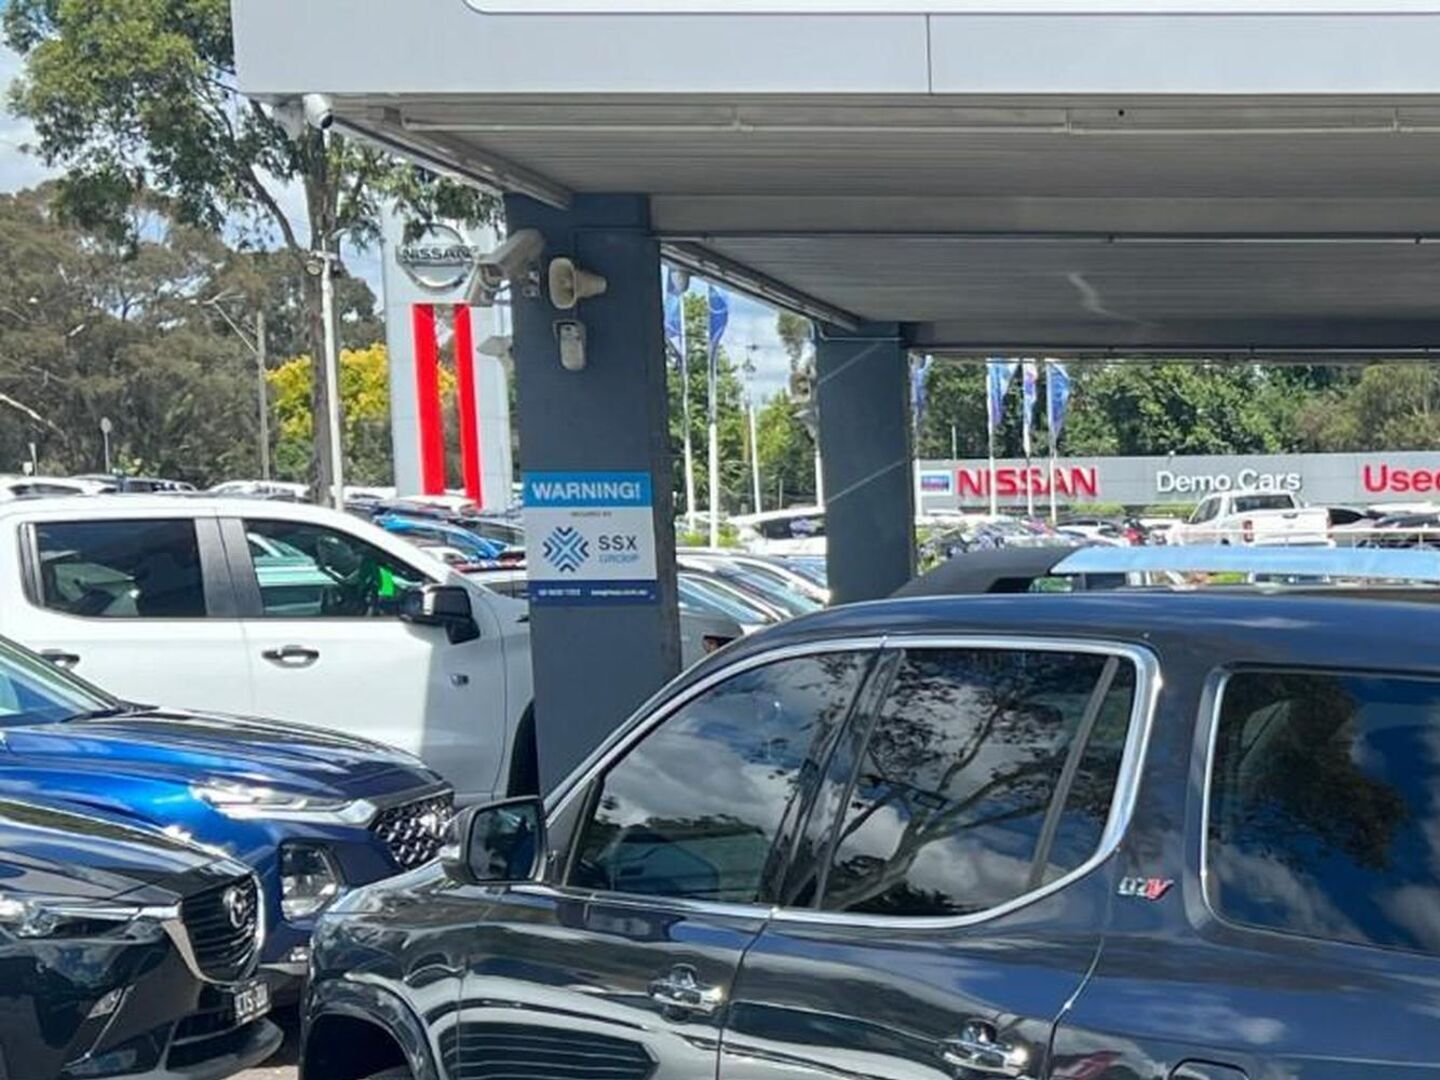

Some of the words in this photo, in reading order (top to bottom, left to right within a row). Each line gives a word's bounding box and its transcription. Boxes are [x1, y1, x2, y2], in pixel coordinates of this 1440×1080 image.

[531, 482, 641, 500] WARNING!
[957, 467, 1098, 497] NISSAN
[1156, 470, 1232, 493] Demo
[1238, 468, 1303, 492] Cars
[597, 534, 638, 551] SSX
